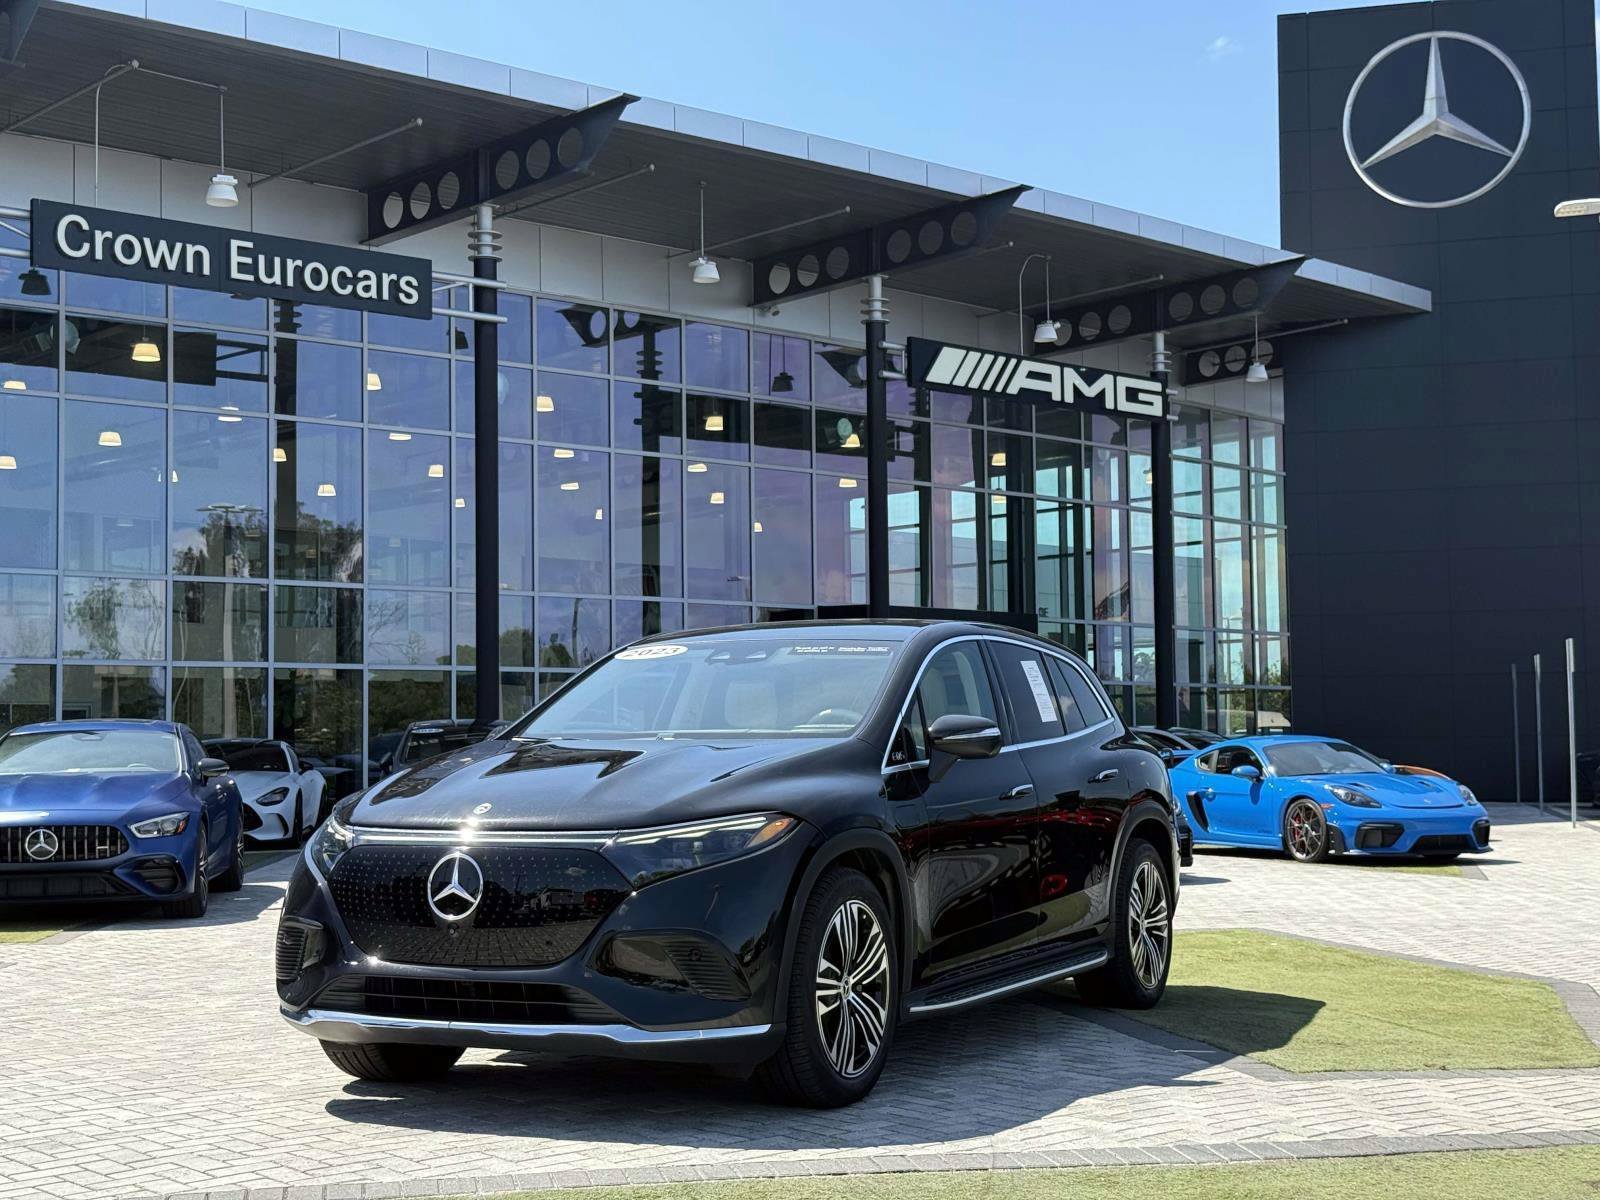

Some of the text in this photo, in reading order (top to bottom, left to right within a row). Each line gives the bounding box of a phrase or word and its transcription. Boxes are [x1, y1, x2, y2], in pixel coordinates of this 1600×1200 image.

[56, 213, 420, 305] Crown Eurocars
[621, 647, 681, 658] 2023
